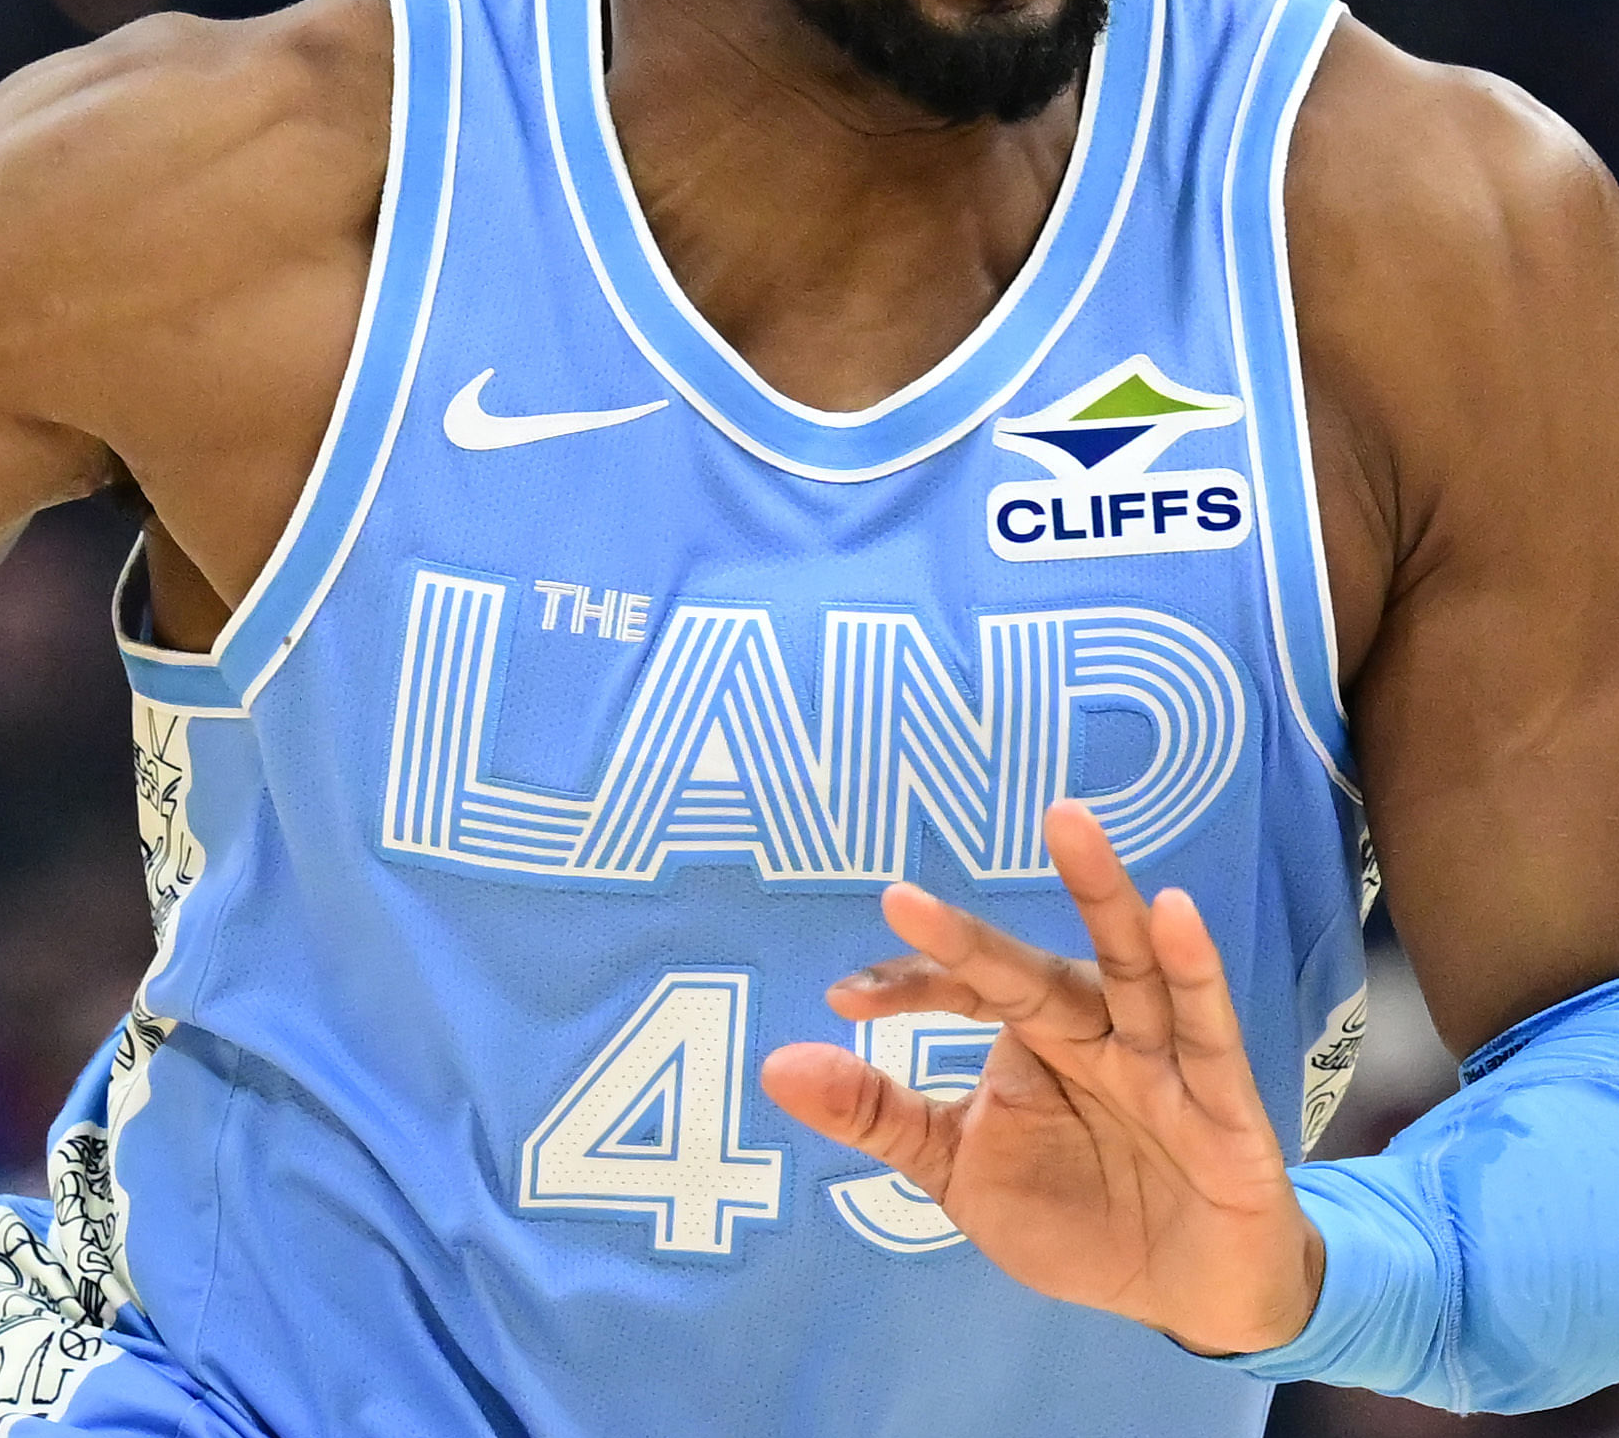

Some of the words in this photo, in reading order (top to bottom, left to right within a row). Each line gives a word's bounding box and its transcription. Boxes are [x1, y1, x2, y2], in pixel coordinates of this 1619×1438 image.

[995, 485, 1243, 543] CLIFFS
[532, 578, 653, 645] THE
[382, 569, 1248, 883] LAND
